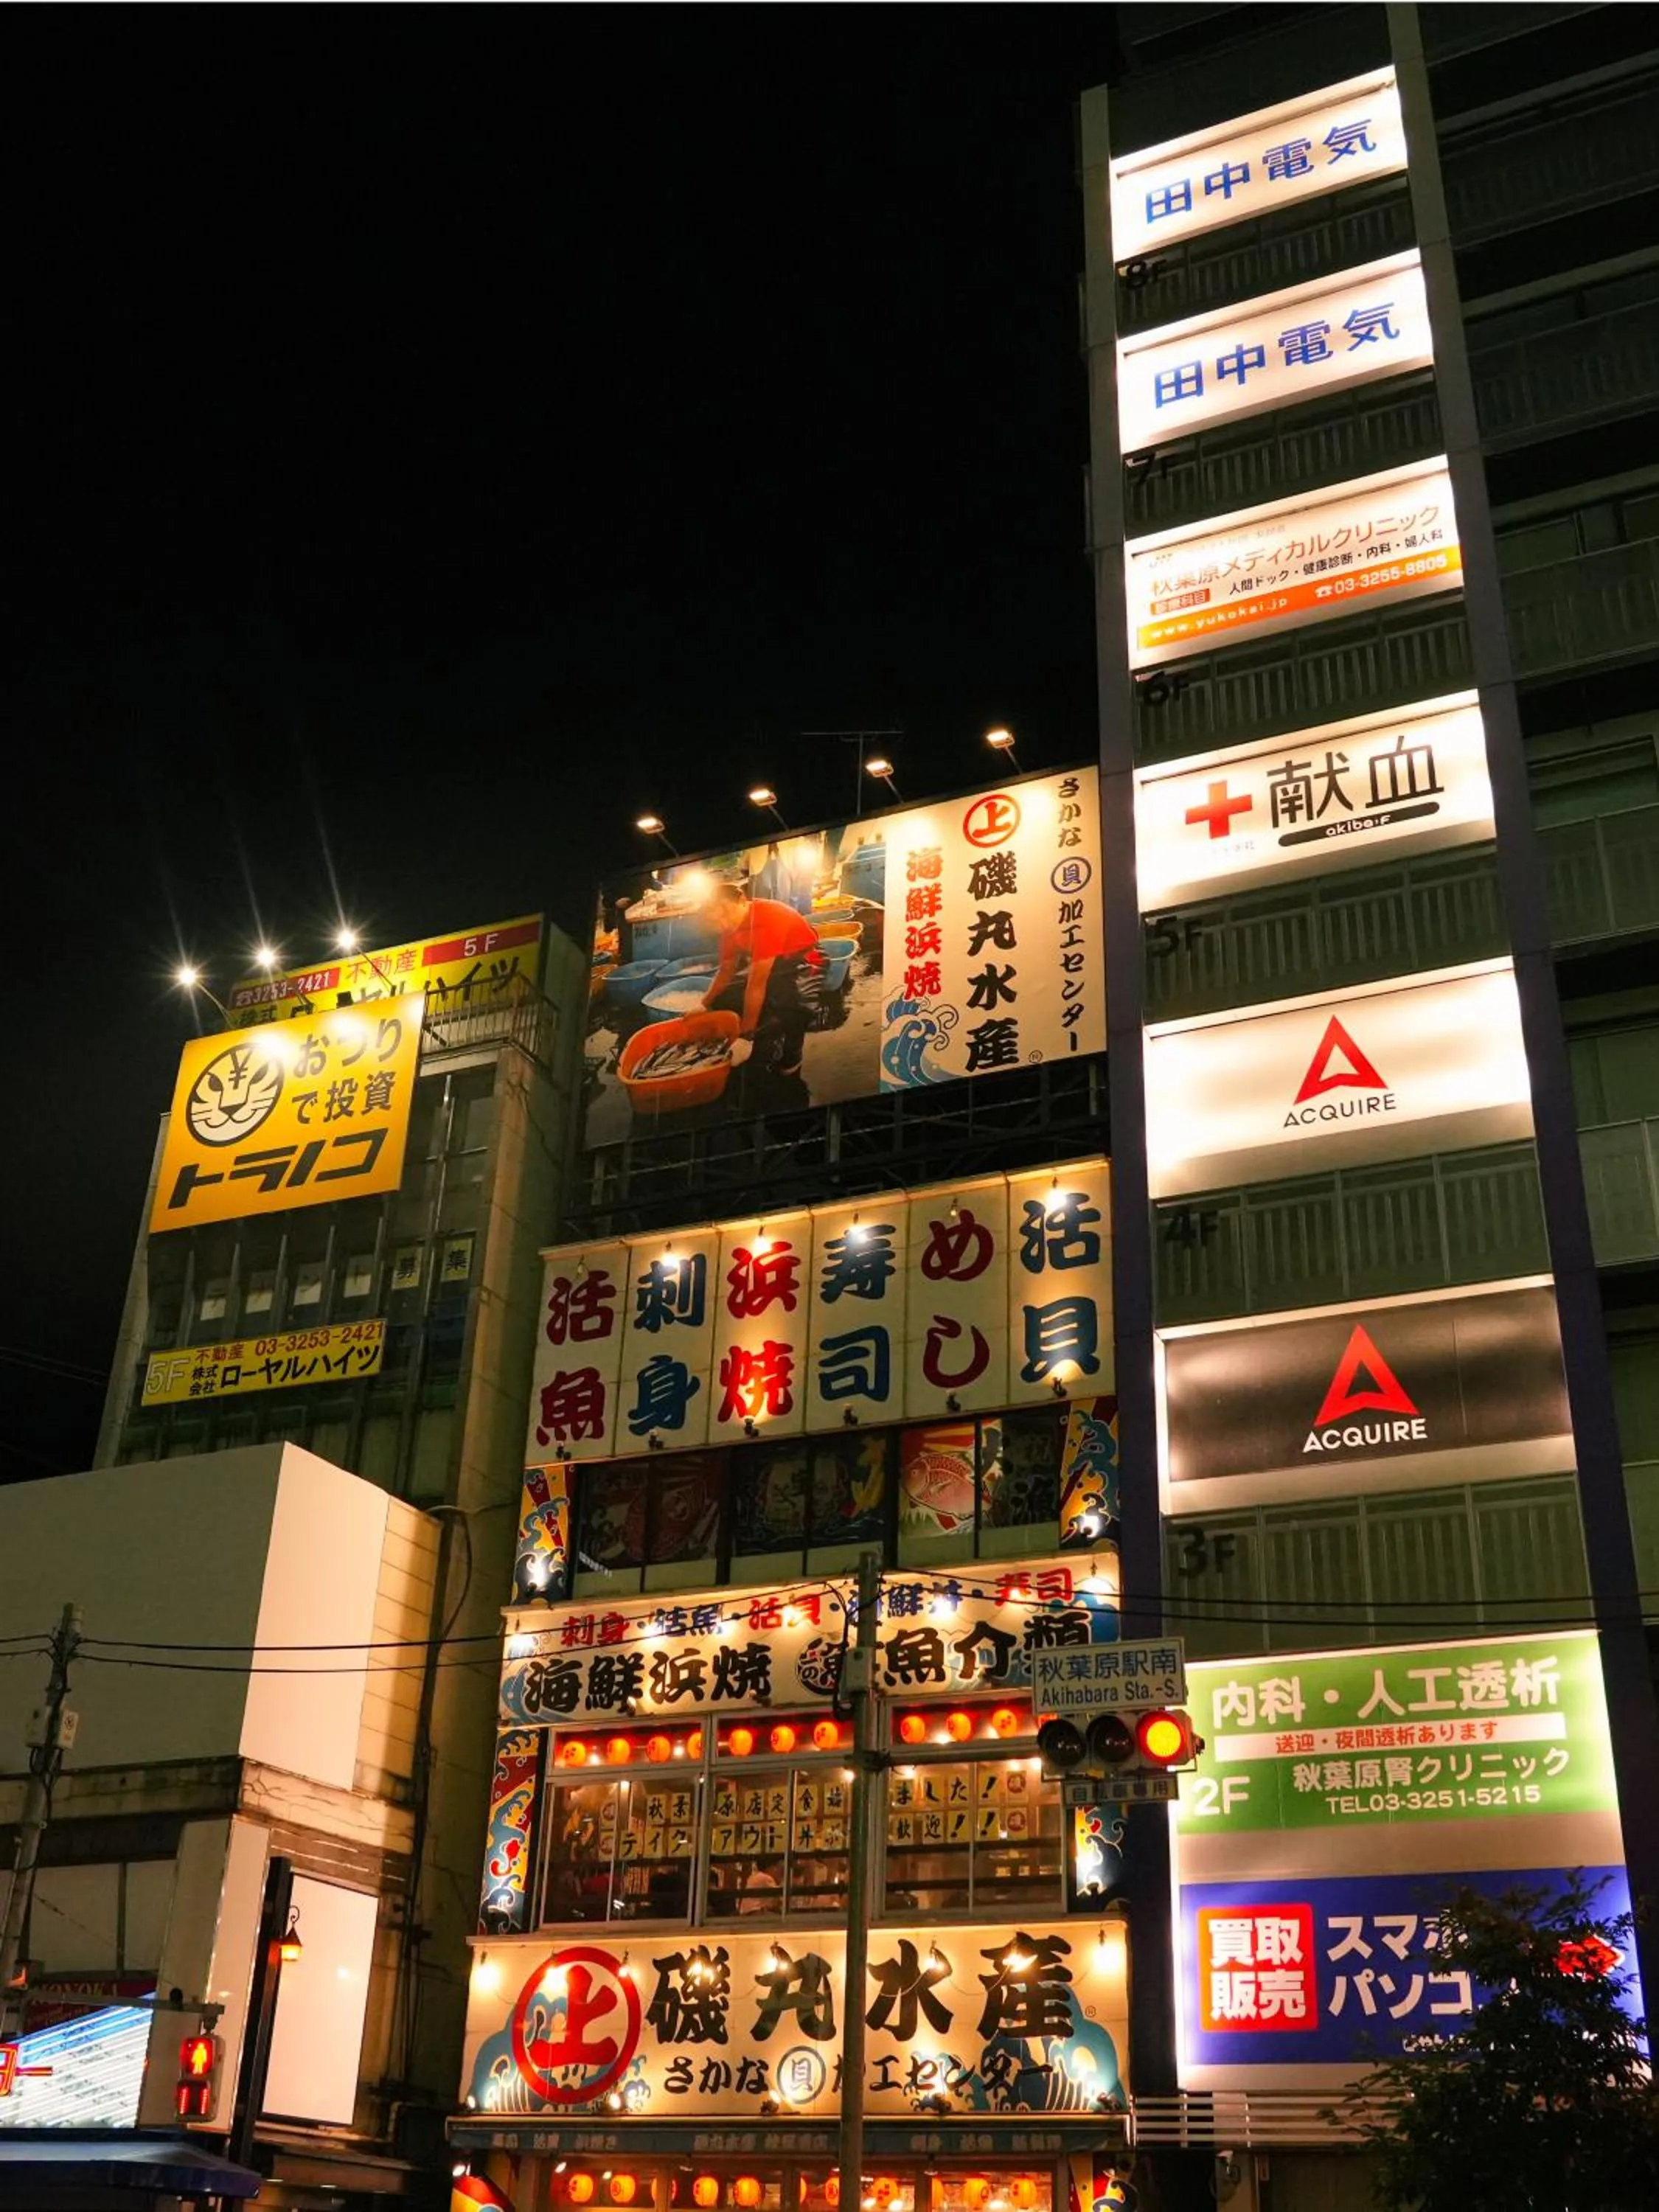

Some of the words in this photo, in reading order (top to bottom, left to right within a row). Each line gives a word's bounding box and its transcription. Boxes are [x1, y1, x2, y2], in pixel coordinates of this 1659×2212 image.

[1145, 119, 1377, 224] 田中電気
[1155, 302, 1400, 408] 田中電気
[1152, 506, 1439, 596] 秋葉原メディカルクリニック
[1267, 736, 1444, 829] 献血
[903, 846, 943, 1001] 海鮮浜焼
[345, 949, 417, 984] 不動産
[965, 851, 1019, 1072] 磯丸水産
[293, 1018, 403, 1079] おつり
[292, 1071, 396, 1125] で投資
[1283, 1093, 1397, 1129] ACQUIRE
[167, 1127, 389, 1209] トラノコ
[818, 1224, 897, 1402] 寿司
[920, 1209, 995, 1388] めし
[1019, 1192, 1102, 1383] 活貝
[195, 1343, 245, 1364] 不動産
[254, 1322, 383, 1356] 03-3253-2421
[536, 1270, 617, 1447] 活魚
[627, 1252, 706, 1436] 刺身
[717, 1240, 801, 1424] 浜焼
[146, 1357, 189, 1395] 5F
[221, 1344, 380, 1388] ローヤルハイツ
[1303, 1417, 1427, 1453] ACQUIRE
[1178, 1528, 1236, 1577] 3F
[524, 1642, 771, 1714] 海鮮浜焼
[1038, 1648, 1178, 1683] 秋葉原駅南
[1212, 1656, 1561, 1729] 内科・人工透析
[1041, 1686, 1119, 1707] Akihabara
[1275, 1721, 1498, 1754] 送迎・夜間透析あります
[1191, 1775, 1251, 1818] 2F
[1293, 1747, 1571, 1793] 秋葉原腎クリニック
[1326, 1784, 1542, 1815] TEL03-3251-5215
[1208, 1916, 1304, 1968] 買取
[646, 1931, 1075, 2046] 磯丸水産
[1210, 1971, 1307, 2020] 販売
[1328, 1968, 1504, 2020] パソコ
